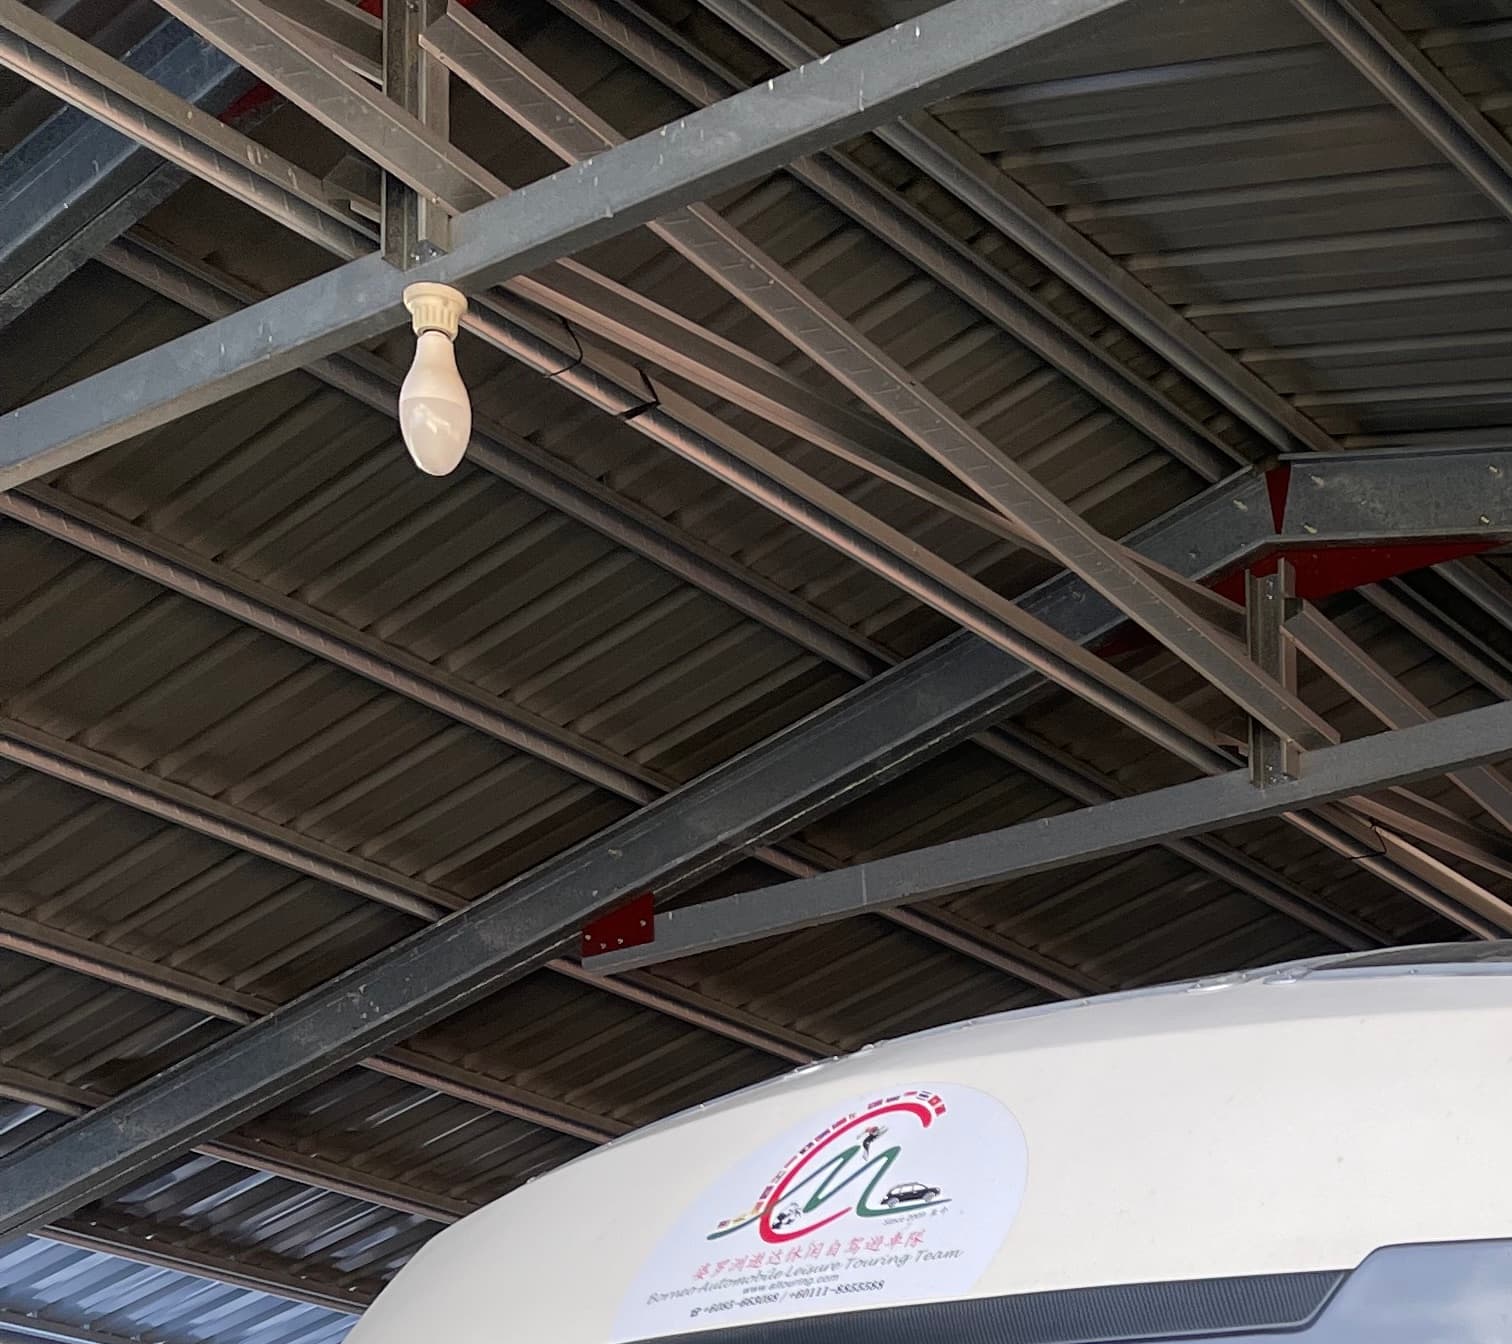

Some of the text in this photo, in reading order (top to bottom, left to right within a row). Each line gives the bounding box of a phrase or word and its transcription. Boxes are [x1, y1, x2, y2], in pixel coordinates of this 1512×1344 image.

[785, 1260, 841, 1281] Leisure
[844, 1253, 911, 1271] Touring
[915, 1248, 963, 1263] Team
